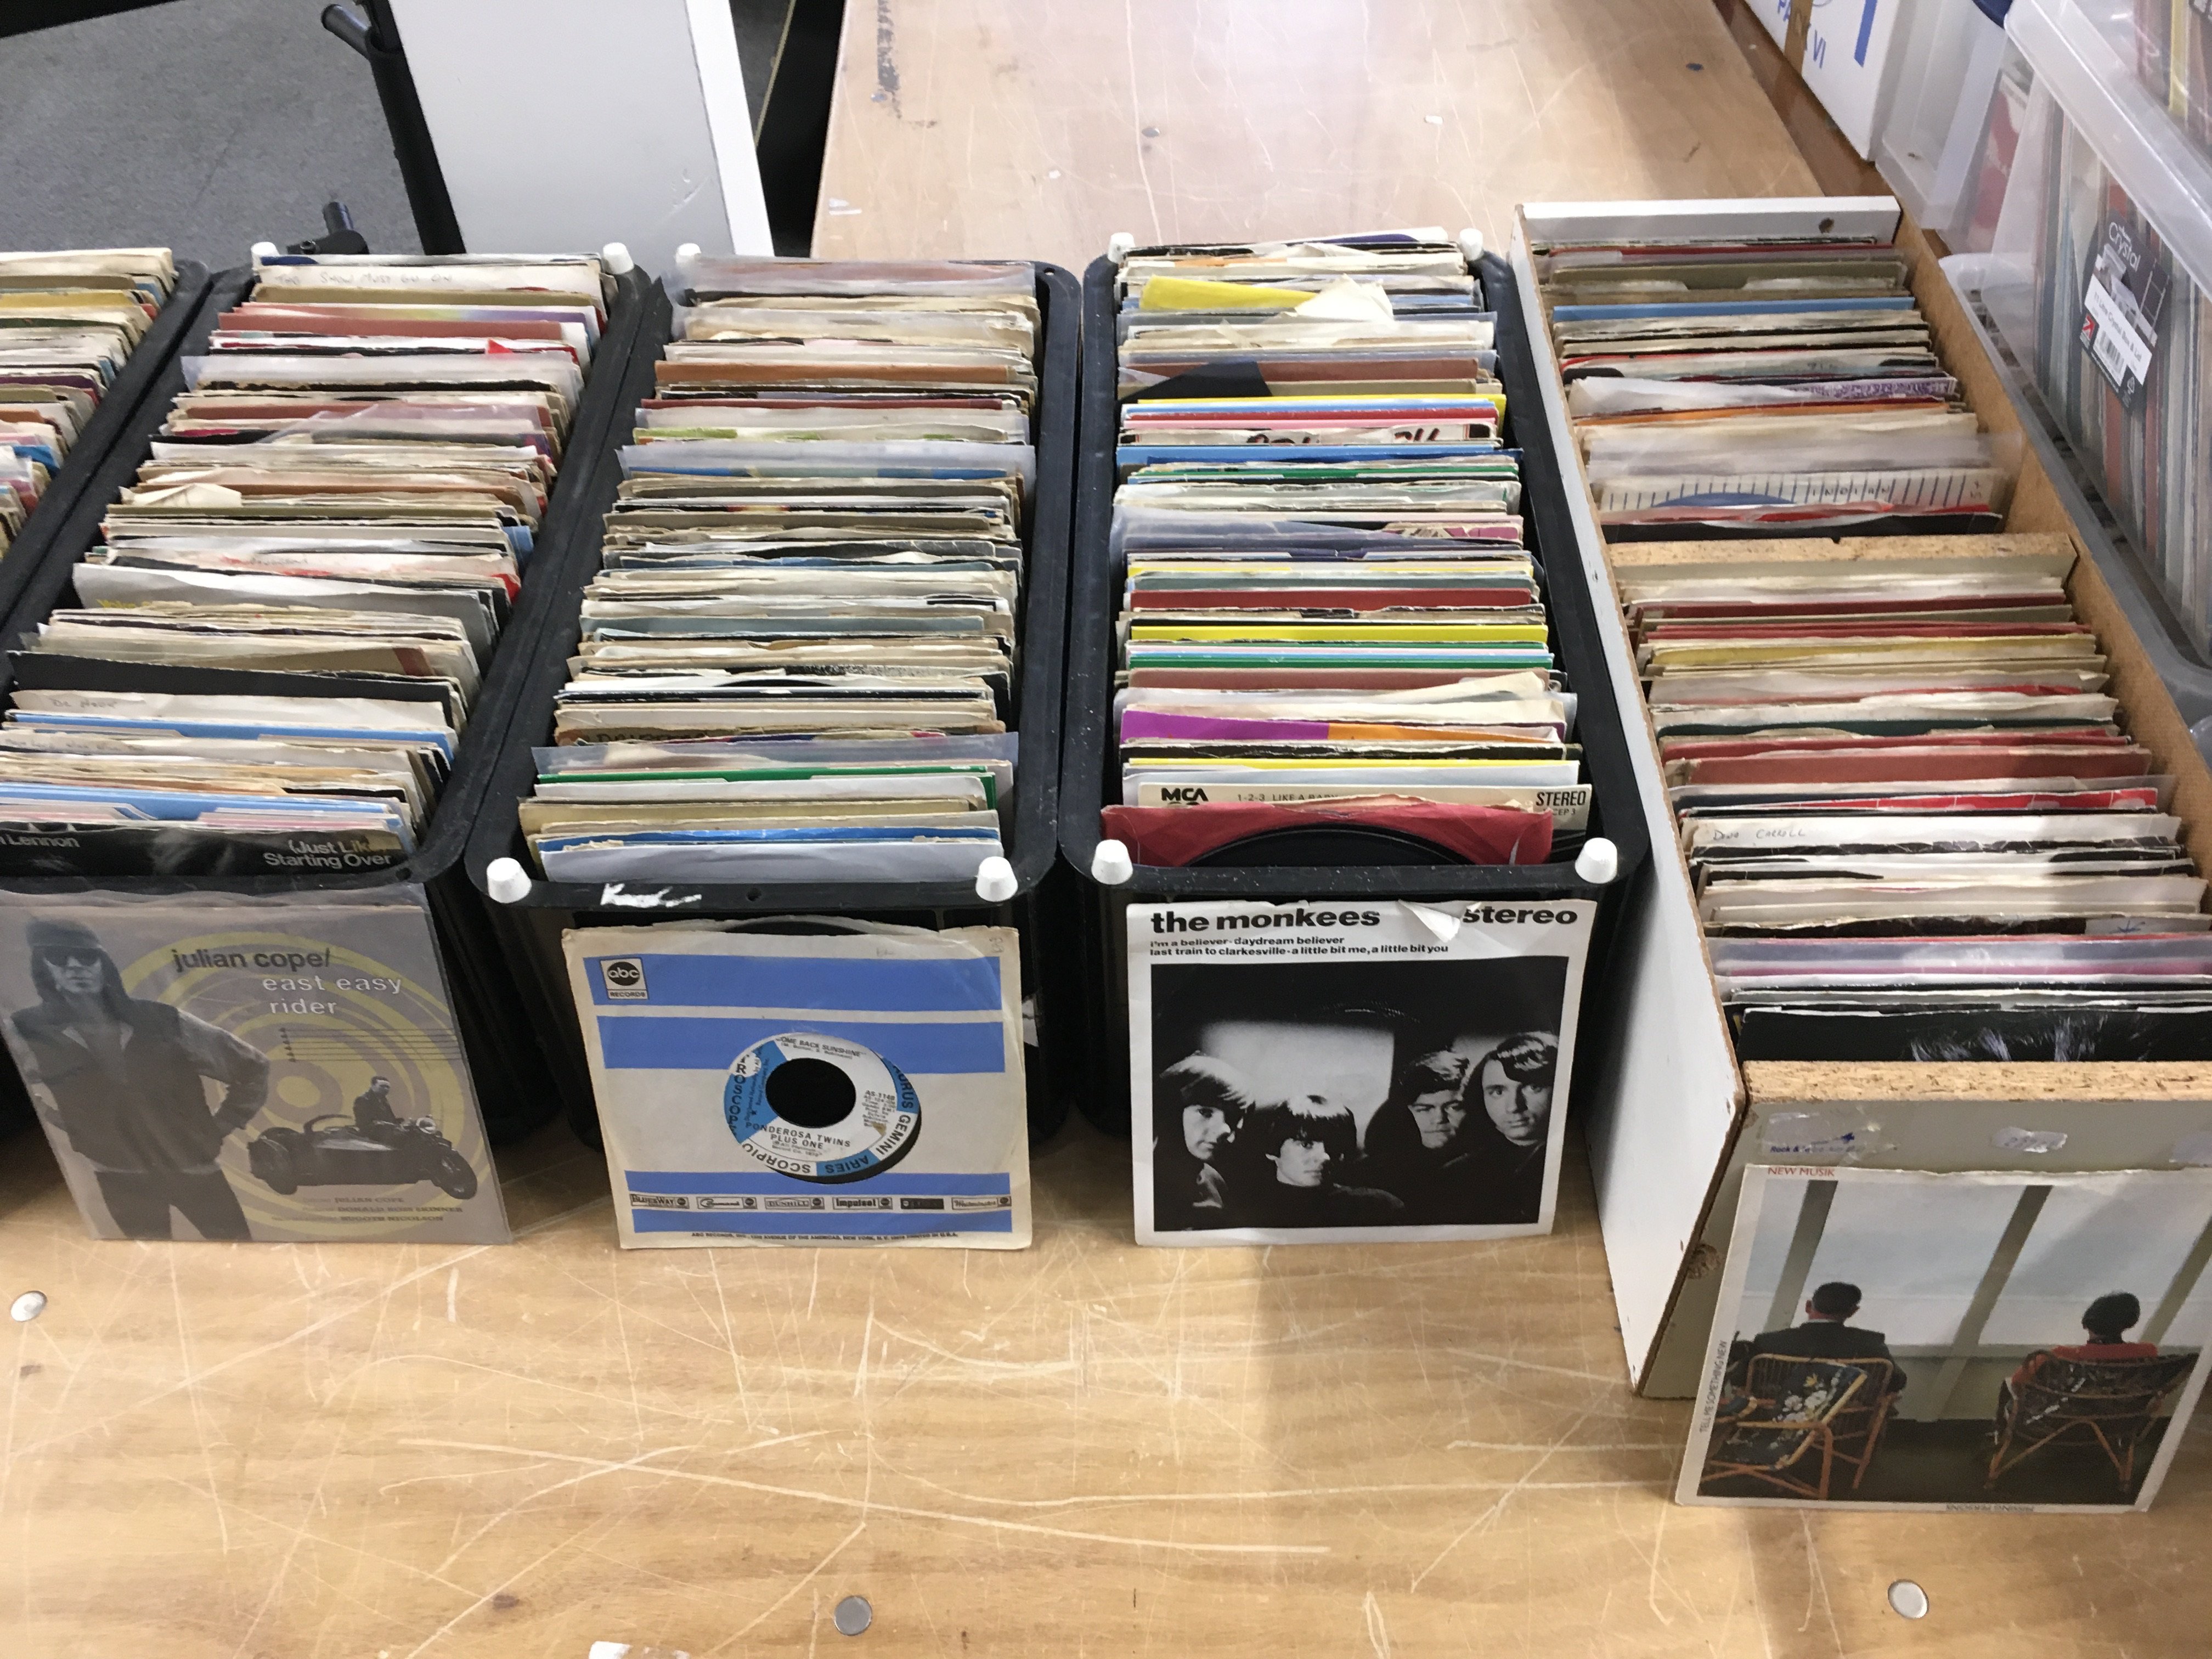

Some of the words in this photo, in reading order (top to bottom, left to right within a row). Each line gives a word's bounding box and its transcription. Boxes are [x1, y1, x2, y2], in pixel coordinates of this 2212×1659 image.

[2108, 222, 2141, 272] Crystal
[1160, 788, 1209, 802] MCA
[1536, 791, 1587, 806] STEREO
[6, 829, 81, 848] Lennon
[287, 839, 338, 854] (Just
[337, 840, 370, 853] Lik
[263, 853, 343, 870] Starting
[343, 854, 392, 866] Over
[1151, 911, 1210, 933] the
[1216, 908, 1381, 930] monkees
[1463, 906, 1578, 924] stereo
[1296, 936, 1345, 945] believer
[1330, 945, 1346, 953] bit
[1380, 944, 1408, 953] little
[1410, 944, 1426, 952] bit
[1427, 945, 1449, 953] you
[172, 949, 248, 973] julian
[608, 967, 640, 978] abc
[262, 975, 326, 991] east
[336, 977, 402, 995] easy
[269, 998, 337, 1014] rider
[799, 1040, 820, 1048] BACK
[746, 1122, 811, 1140] PONDEROSA
[817, 1135, 851, 1148] TWINS
[770, 1134, 798, 1144] PLUS
[802, 1140, 823, 1149] ONE
[875, 1114, 911, 1155] GEMINI
[742, 1143, 811, 1174] SCORPIO
[824, 1155, 870, 1174] ARIES
[1768, 1167, 1796, 1176] NEW
[1799, 1167, 1835, 1177] MUSIK
